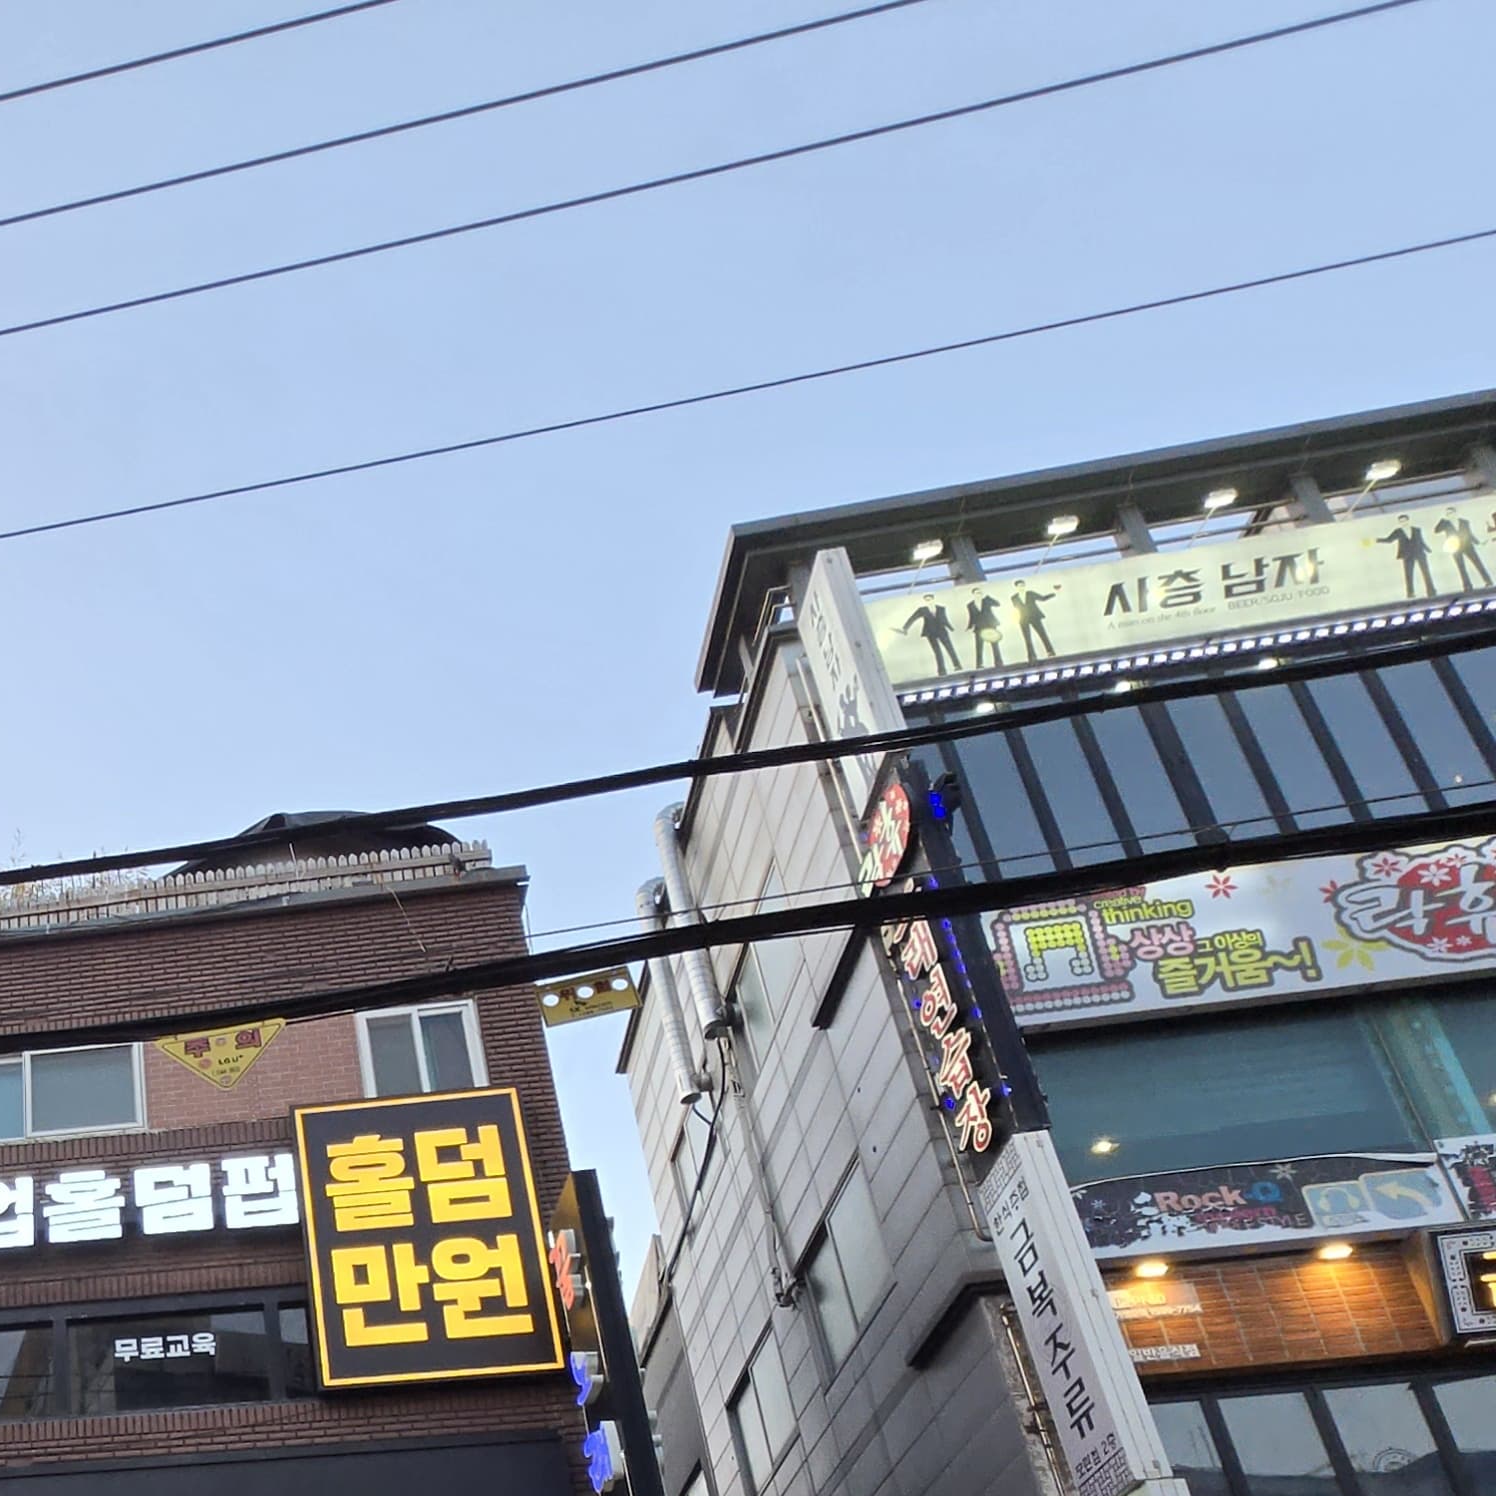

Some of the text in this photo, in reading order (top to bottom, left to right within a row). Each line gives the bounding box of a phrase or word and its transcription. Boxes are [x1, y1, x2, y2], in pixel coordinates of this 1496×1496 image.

[1220, 547, 1324, 599] 남자
[1102, 900, 1191, 923] thinking
[1130, 921, 1196, 960] 상상
[326, 1124, 512, 1232] 홀덤
[1155, 1184, 1248, 1213] Rock
[331, 1233, 534, 1347] 만원
[114, 1331, 217, 1362] 무료교육
